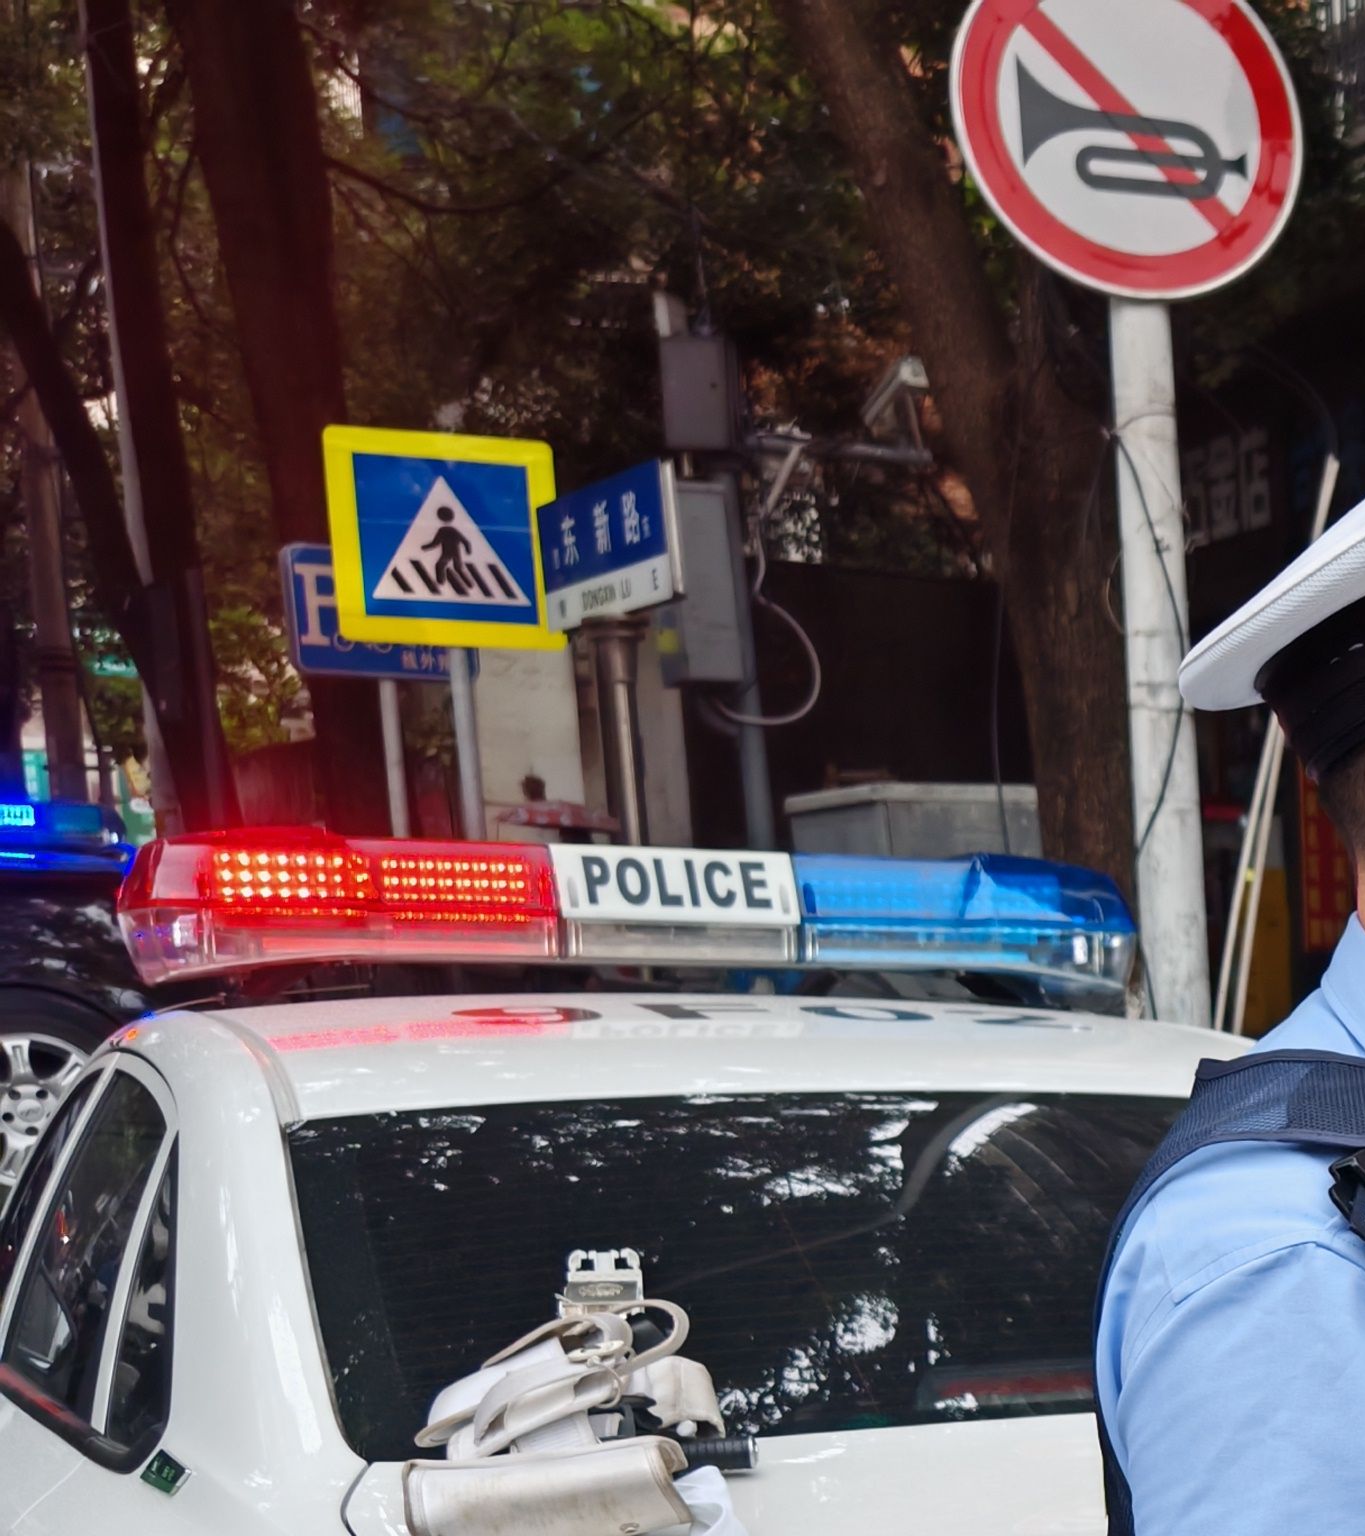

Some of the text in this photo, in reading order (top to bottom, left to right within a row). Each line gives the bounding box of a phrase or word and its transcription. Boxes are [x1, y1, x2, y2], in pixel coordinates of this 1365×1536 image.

[561, 490, 641, 567] 东新路
[581, 856, 773, 908] POLICE
